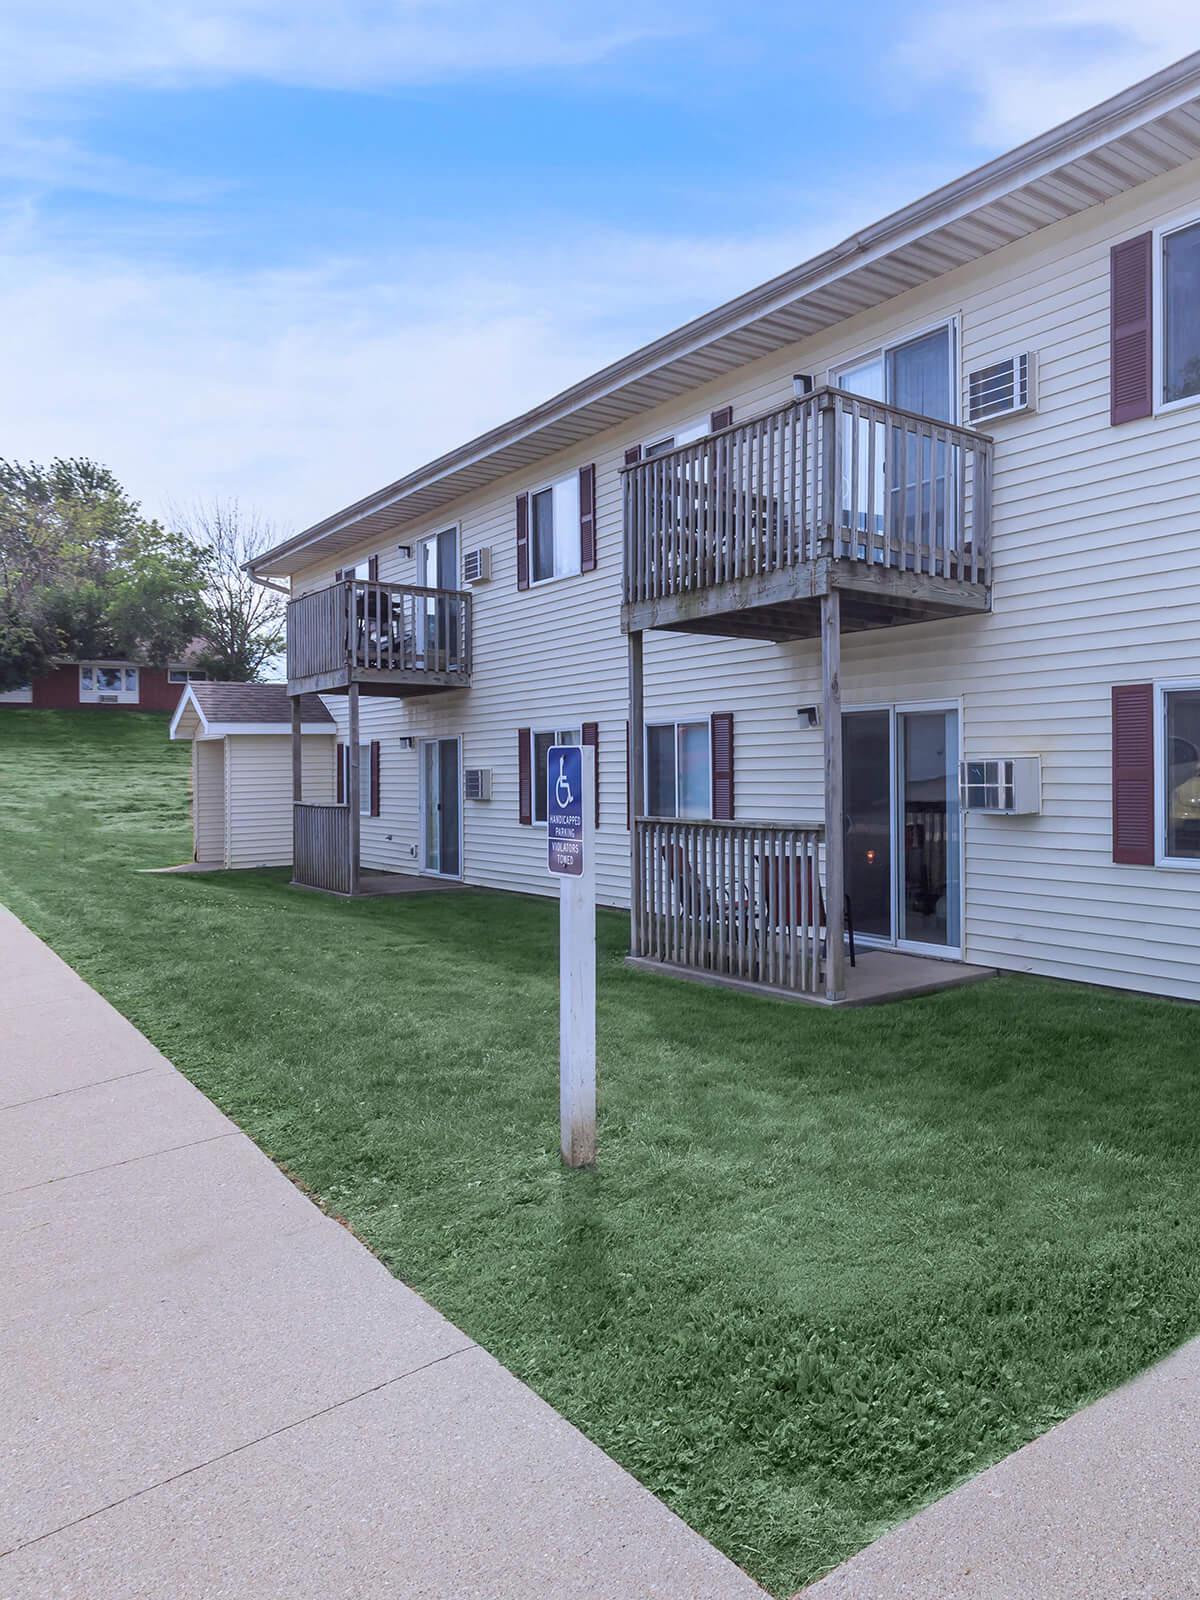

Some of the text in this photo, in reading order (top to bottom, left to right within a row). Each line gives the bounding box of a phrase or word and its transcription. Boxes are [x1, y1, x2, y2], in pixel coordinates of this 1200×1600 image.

[550, 815, 581, 826] HANDICAPPED
[555, 827, 575, 838] PARKING
[551, 842, 579, 854] VIOLATORS
[557, 854, 574, 865] TOWED
